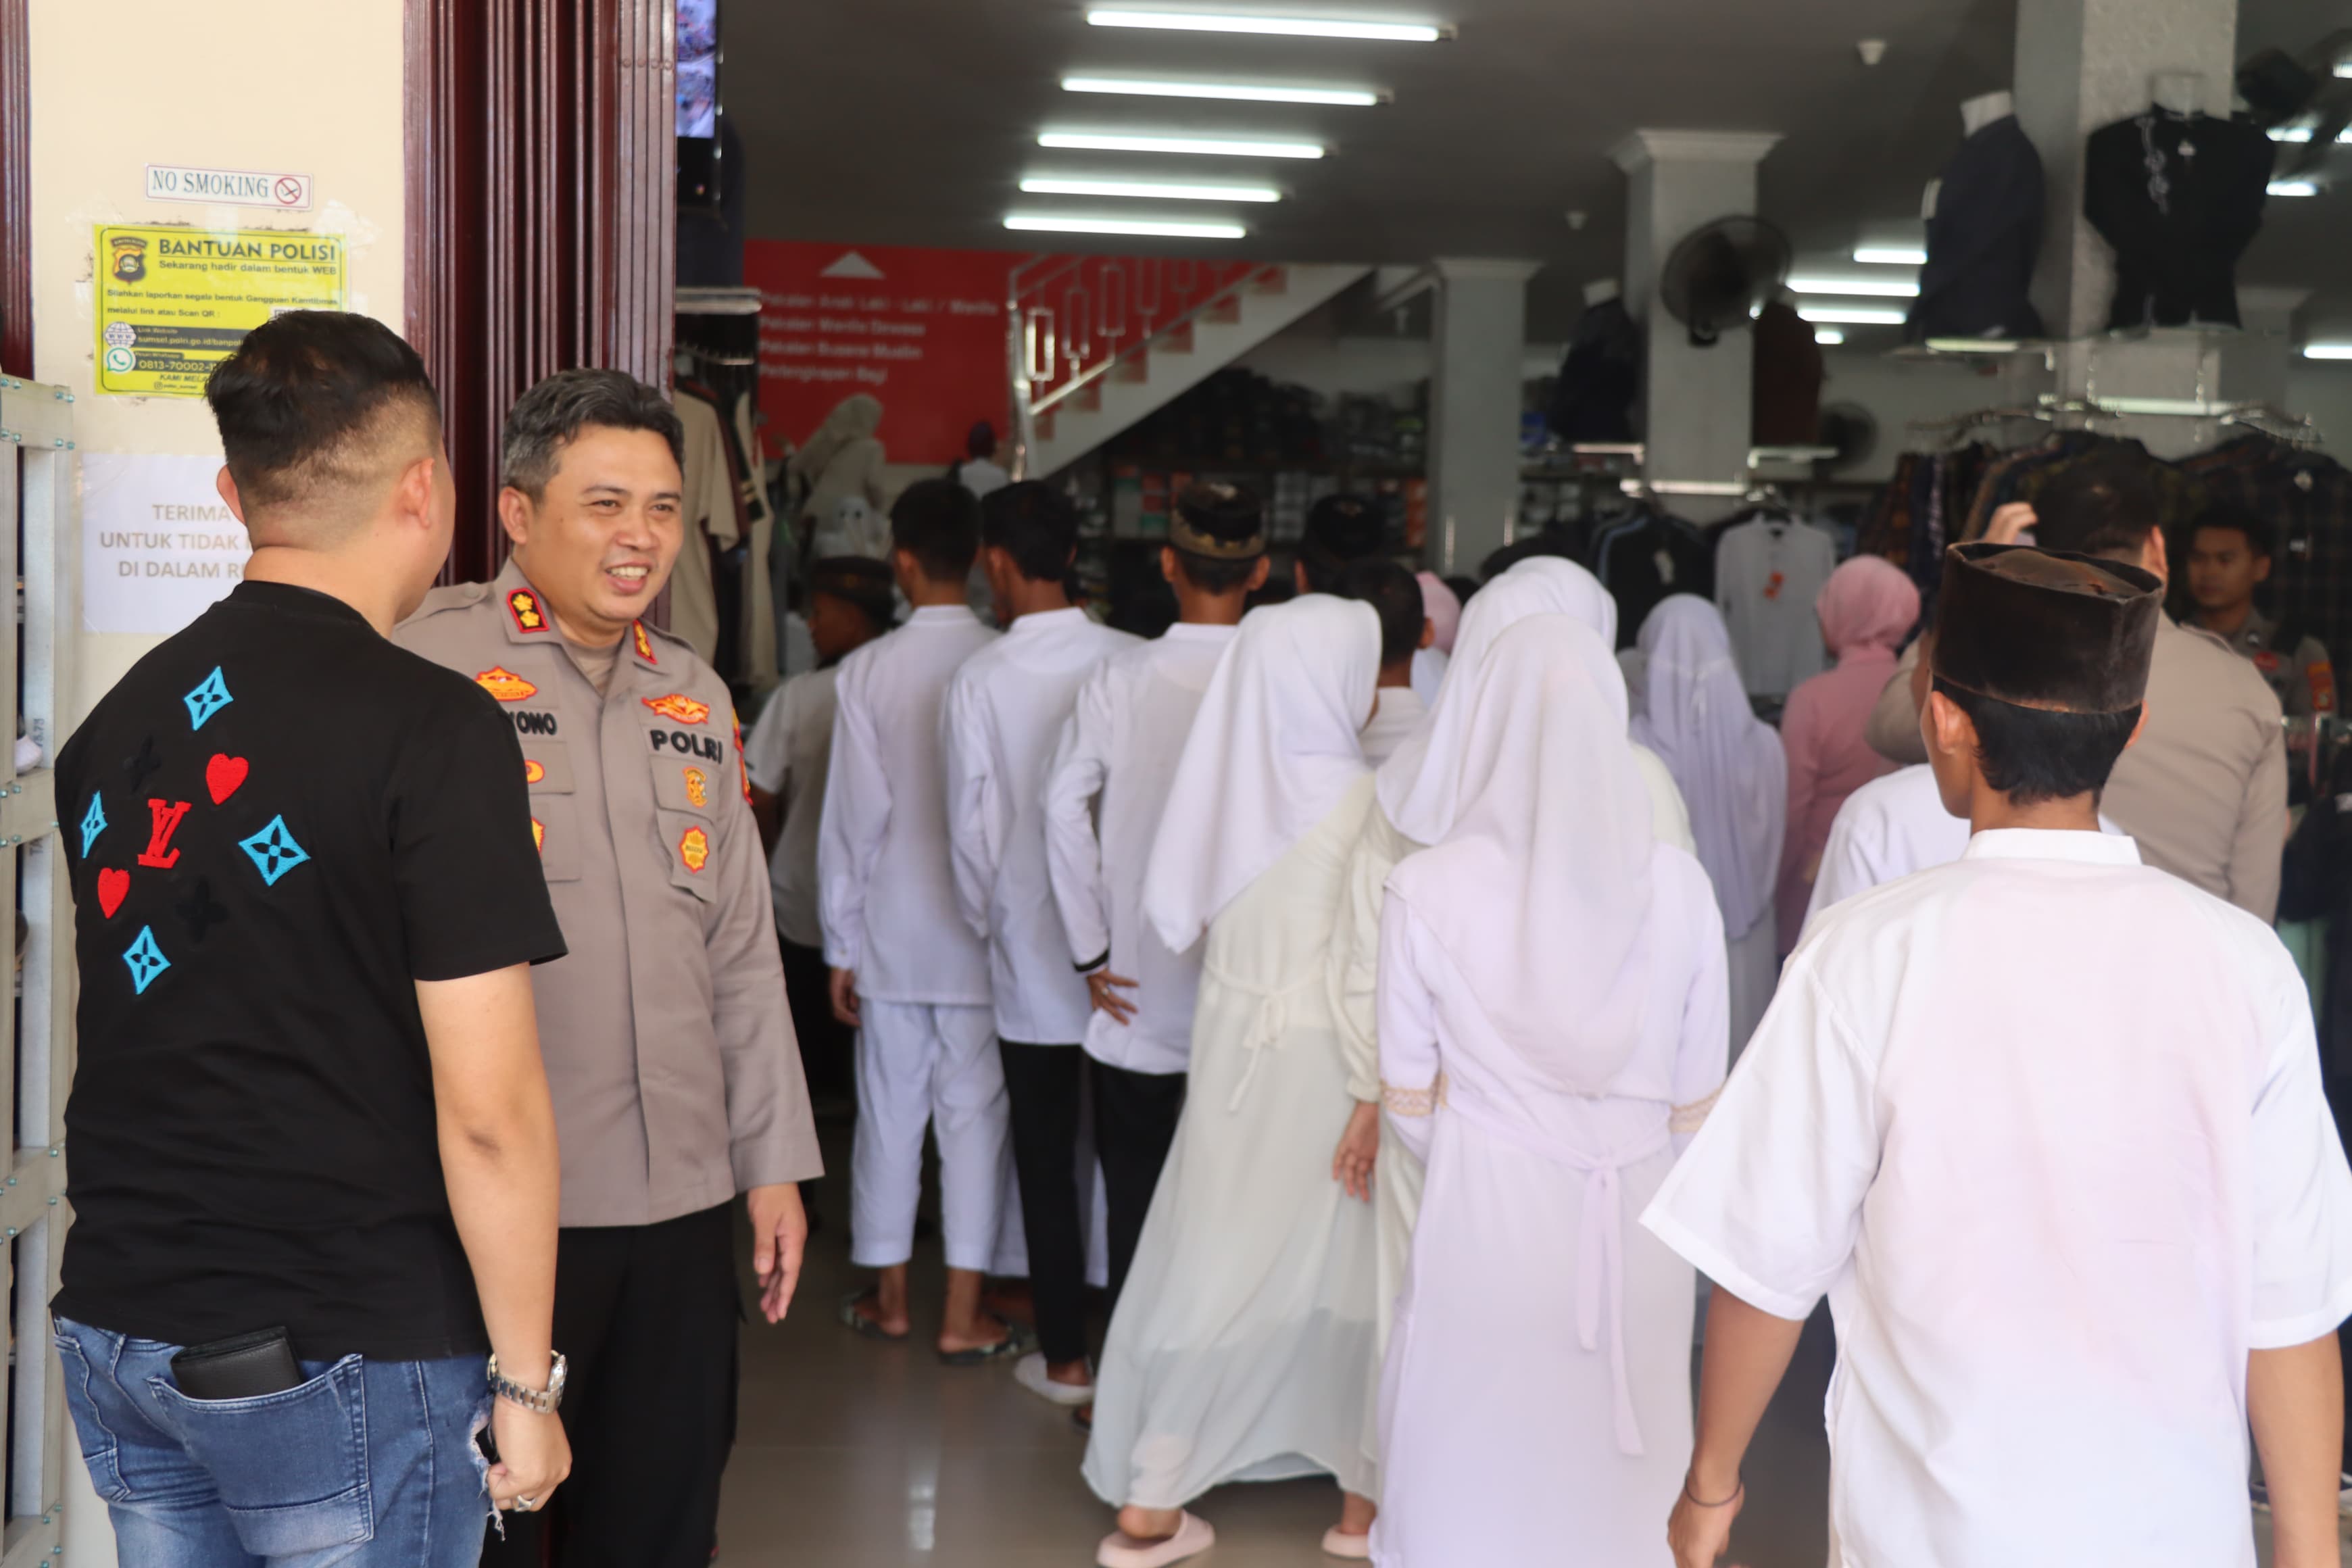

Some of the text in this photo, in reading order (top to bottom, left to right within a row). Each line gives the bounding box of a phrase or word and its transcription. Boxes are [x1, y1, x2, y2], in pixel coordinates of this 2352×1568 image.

[153, 170, 268, 198] NO SMOKING
[160, 239, 262, 257] BANTUAN
[271, 243, 335, 261] POLISI
[160, 260, 337, 275] Sekarang hadir dalam bentuk WEB
[146, 291, 182, 299] laporkan
[185, 293, 212, 301] segala
[215, 293, 243, 301] bentuk
[246, 295, 289, 304] Gangguan
[178, 309, 199, 317] Scan
[201, 310, 215, 318] QR
[153, 504, 231, 522] TERIMA
[101, 532, 172, 549] UNTUK
[178, 533, 239, 550] TIDAK
[119, 561, 139, 577] DI
[147, 561, 220, 578] DALAM
[649, 730, 723, 764] POLRI
